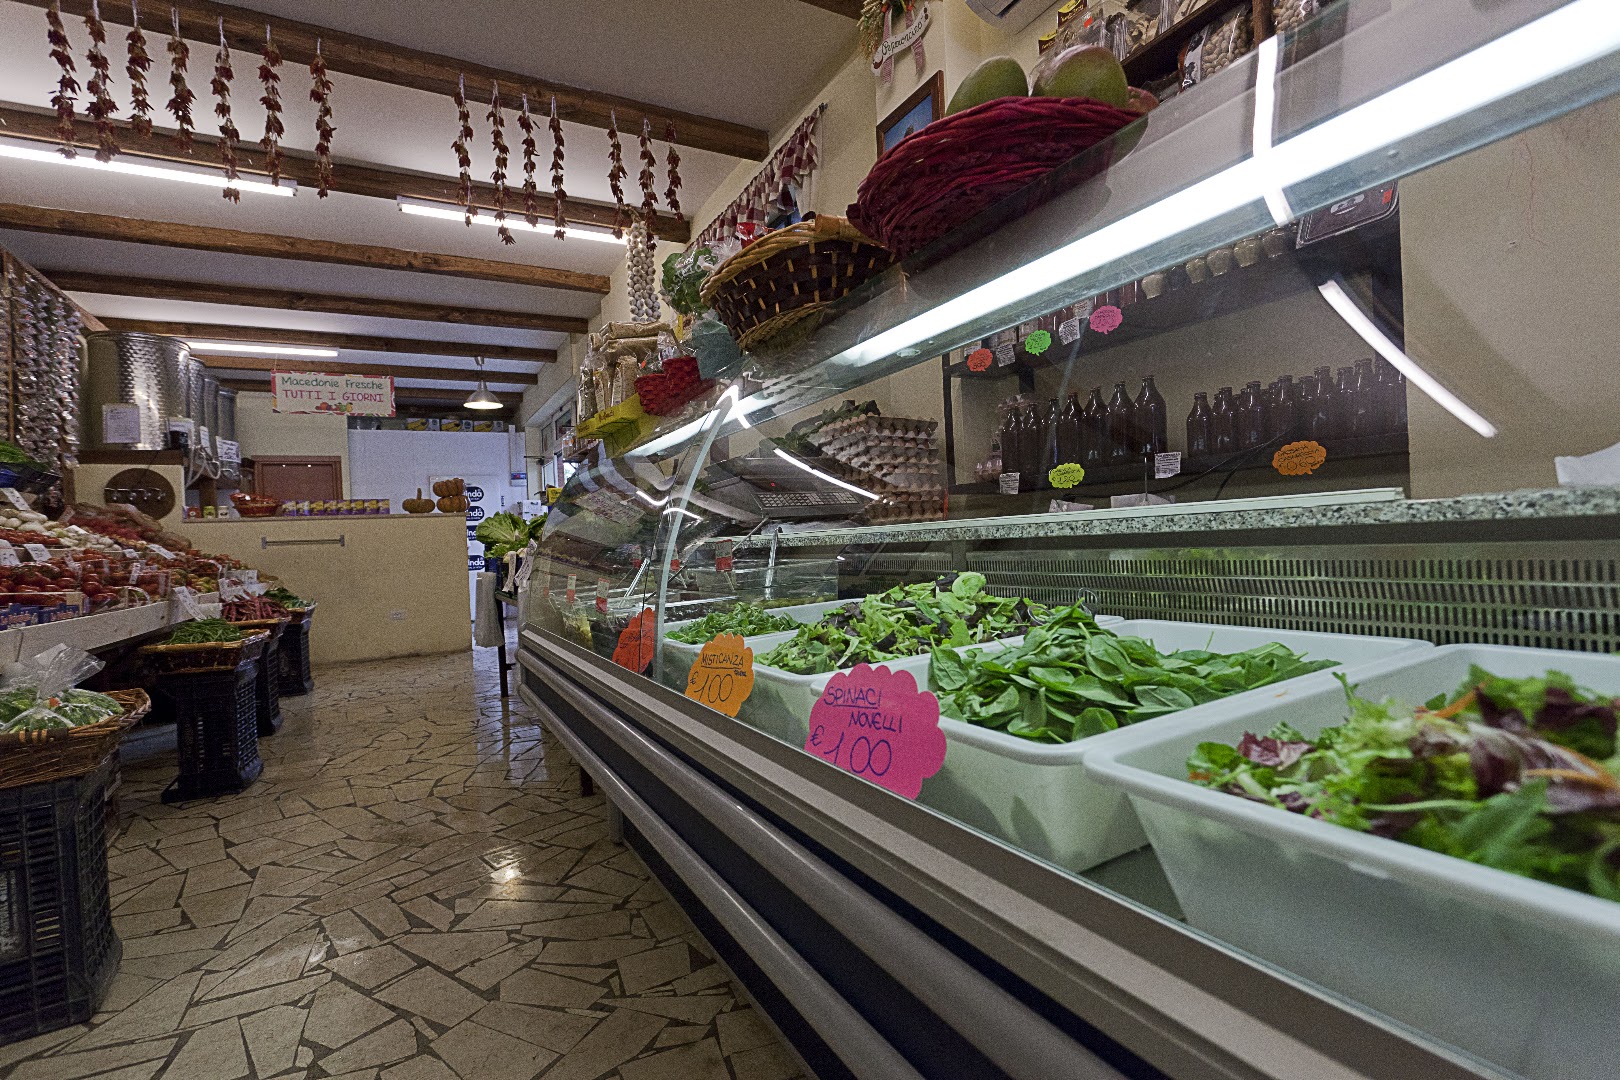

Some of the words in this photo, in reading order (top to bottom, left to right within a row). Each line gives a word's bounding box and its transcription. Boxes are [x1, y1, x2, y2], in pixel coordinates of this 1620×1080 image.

[281, 376, 339, 388] Macedonie
[345, 379, 383, 390] Fresche
[282, 389, 322, 400] TUTTI
[328, 391, 336, 401] I
[342, 391, 384, 403] GIORNI
[701, 653, 744, 668] MISTICANZA
[823, 686, 882, 707] SPINACI
[848, 710, 903, 734] NOVELLI
[810, 724, 825, 747] €
